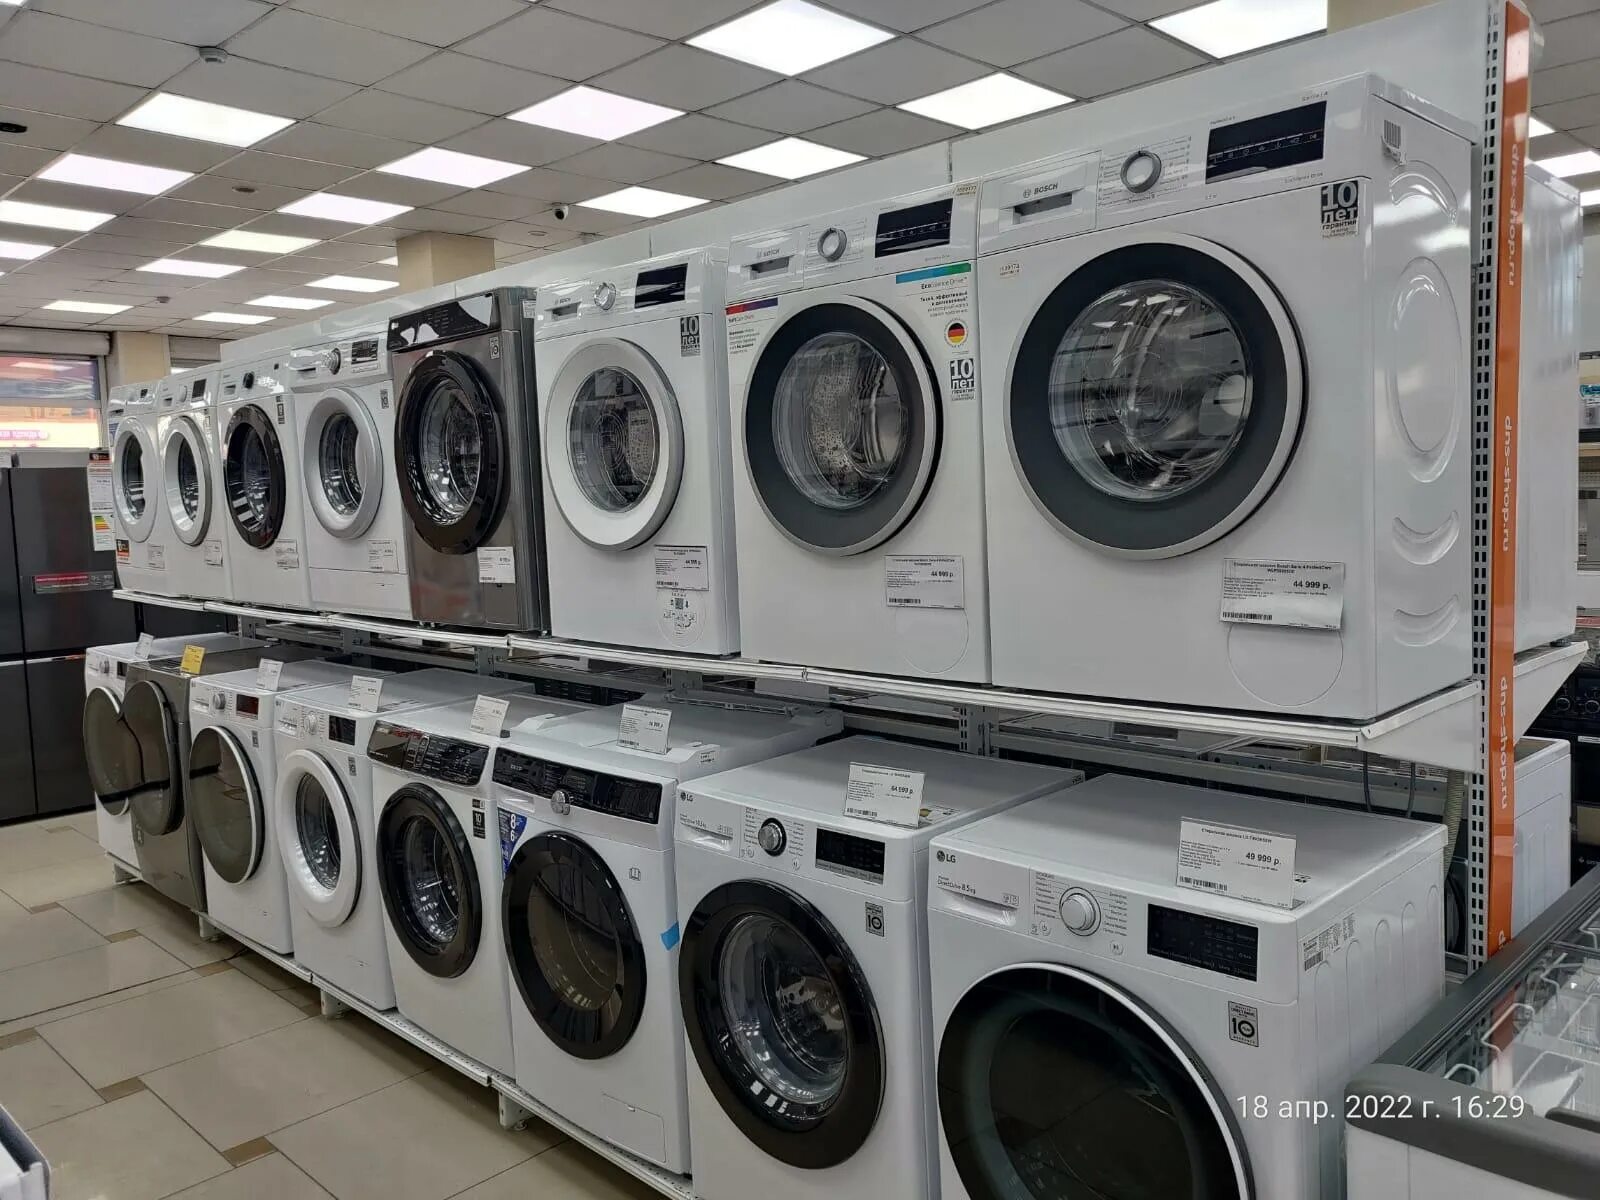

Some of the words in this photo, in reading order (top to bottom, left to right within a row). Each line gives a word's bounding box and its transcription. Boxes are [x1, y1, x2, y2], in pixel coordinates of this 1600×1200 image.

[1033, 183, 1059, 196] BOSCH
[1322, 181, 1357, 211] 10
[1322, 207, 1357, 224] лет
[1507, 144, 1521, 287] dns-shop.ru
[681, 316, 699, 336] 10
[682, 335, 700, 346] лет
[950, 359, 974, 380] 10
[951, 377, 974, 389] лет
[1502, 415, 1513, 552] dns-shop.ru
[1293, 580, 1303, 588] 44
[1305, 580, 1321, 589] 999
[1499, 676, 1508, 809] dns-shop.ru
[946, 854, 956, 864] LG
[1245, 851, 1255, 860] 49
[1257, 853, 1272, 863] 999
[867, 914, 883, 930] 10
[1231, 1017, 1255, 1038] 10
